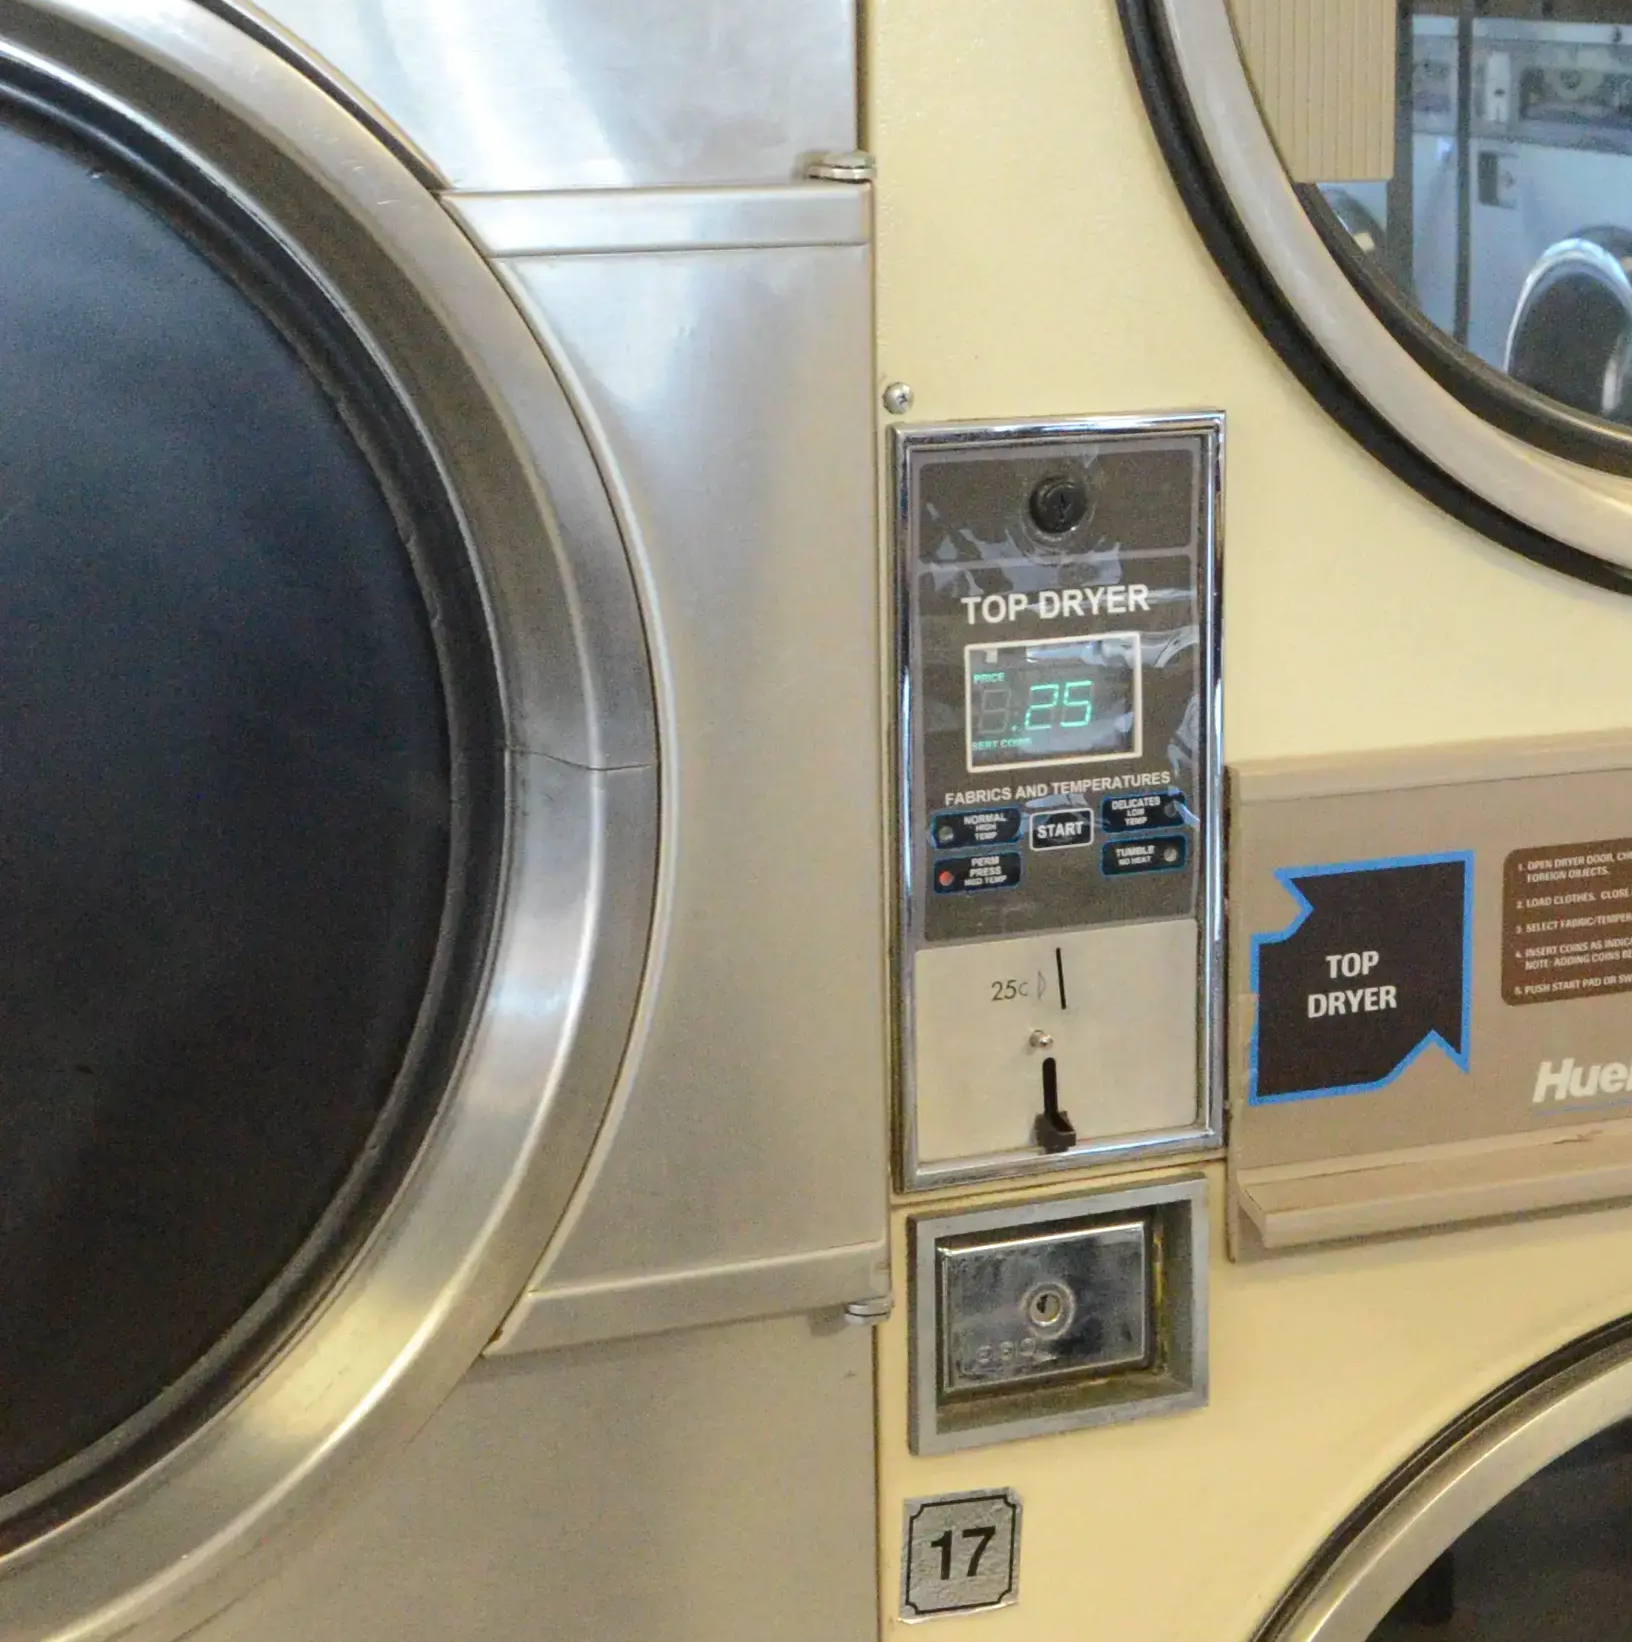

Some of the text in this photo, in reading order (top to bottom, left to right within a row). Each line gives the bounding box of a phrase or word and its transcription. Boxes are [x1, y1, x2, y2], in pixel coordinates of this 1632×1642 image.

[960, 583, 1151, 626] TOP DRYER
[973, 672, 1005, 684] PRICE
[945, 771, 1170, 806] FABRICS AND TEMPERATURES
[1111, 796, 1161, 811] DELICATES
[963, 812, 1007, 825] NORMAL
[1125, 816, 1148, 826] TEMP
[974, 831, 998, 841] TEMP
[1037, 821, 1084, 838] START
[1115, 844, 1155, 858] TUMBLE
[970, 856, 1000, 867] PERM
[1527, 860, 1553, 871] OPEN
[1554, 856, 1585, 868] DRYER
[969, 866, 1002, 877] PRESS
[1527, 870, 1567, 883] FOREIGN
[984, 875, 1007, 885] TEMP
[1526, 896, 1551, 908] LOAD
[1553, 892, 1596, 905] CLOTHES.
[1600, 887, 1629, 899] CLOSE
[1525, 921, 1559, 933] SELECT
[1525, 945, 1557, 958] INSERT
[1559, 941, 1589, 954] COINS
[1590, 939, 1603, 950] AS
[1325, 950, 1379, 979] TOP
[1553, 954, 1590, 967] ADDING
[1591, 949, 1621, 963] COINS
[1524, 983, 1550, 994] PUSH
[1552, 979, 1581, 991] START
[1582, 977, 1602, 988] PAD
[1603, 974, 1617, 985] OR
[1307, 984, 1397, 1019] DRYER
[929, 1525, 997, 1580] 17
